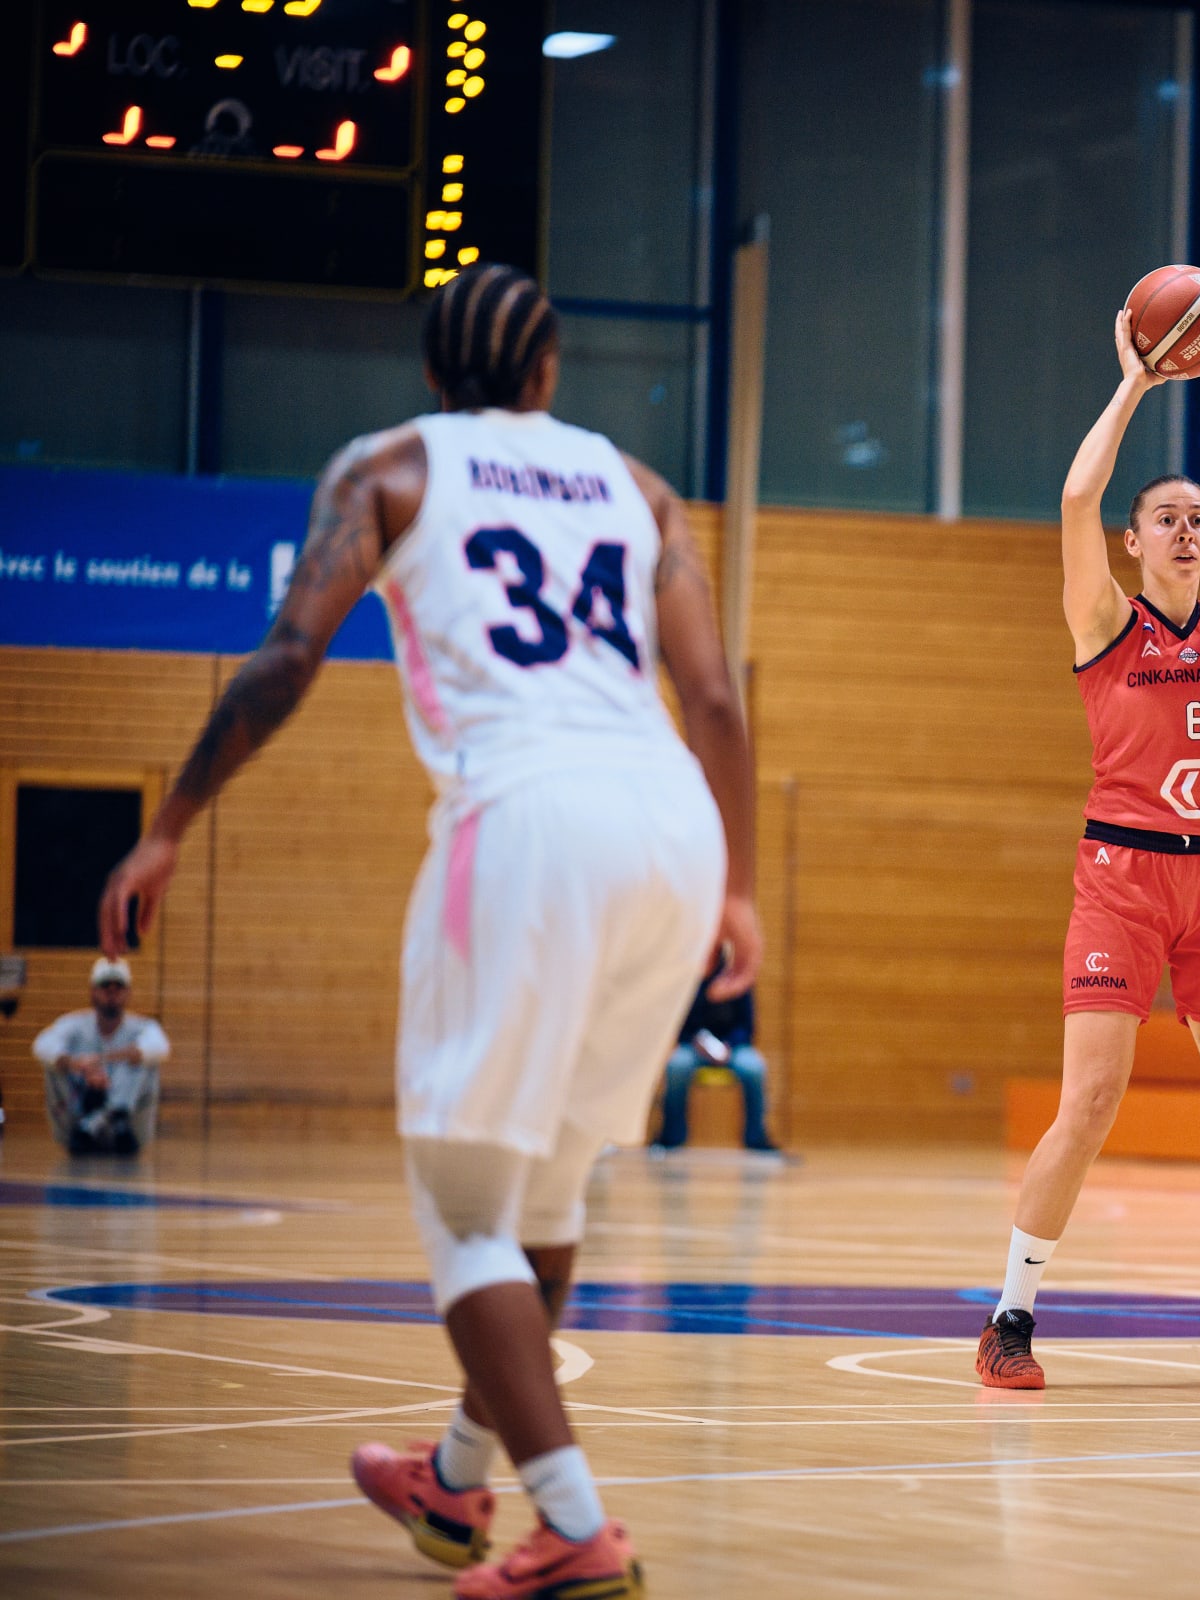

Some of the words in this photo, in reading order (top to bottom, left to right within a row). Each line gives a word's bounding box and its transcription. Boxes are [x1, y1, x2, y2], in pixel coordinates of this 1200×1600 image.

[0, 551, 44, 579] vec
[463, 523, 641, 675] 34
[1071, 975, 1128, 990] CINKARNA
